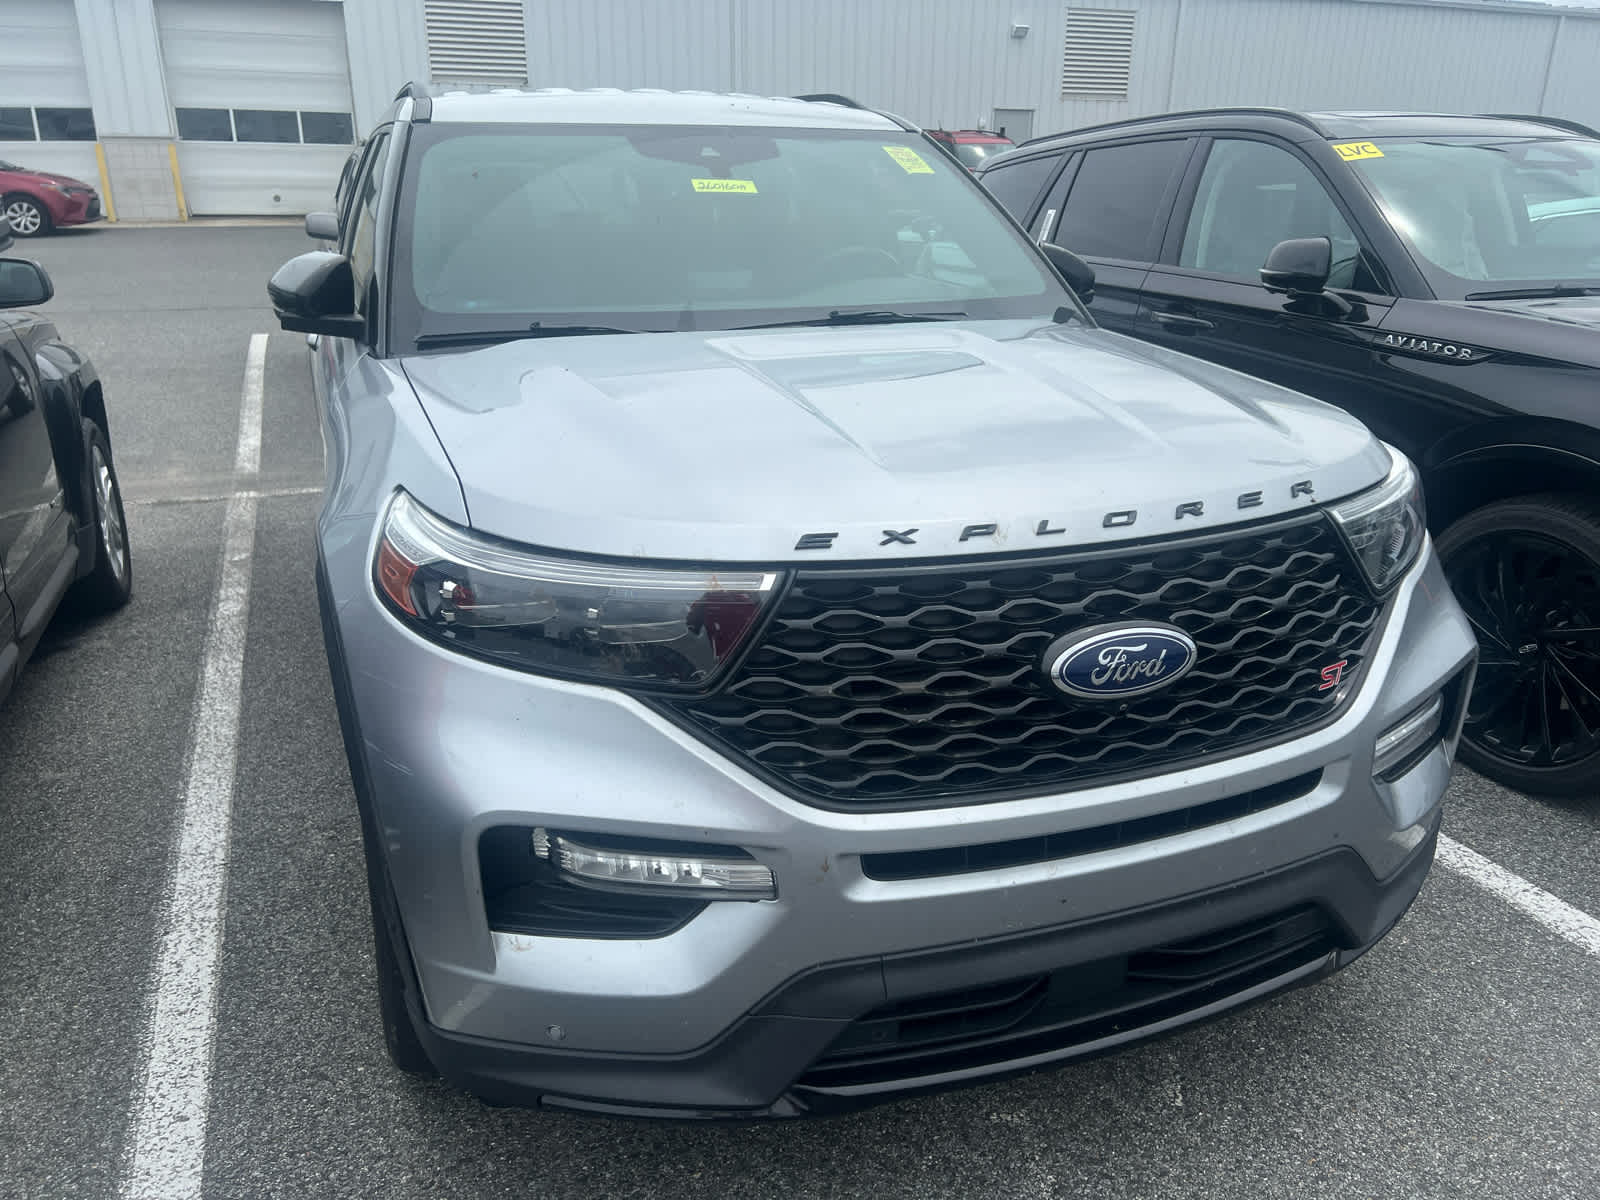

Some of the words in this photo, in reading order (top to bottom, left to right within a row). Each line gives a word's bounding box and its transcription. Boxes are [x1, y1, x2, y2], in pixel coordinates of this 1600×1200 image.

[1336, 144, 1377, 156] LVC
[1384, 334, 1473, 359] AVIATOR
[795, 480, 1314, 551] EXPLORER
[1091, 643, 1167, 685] Ford
[1319, 660, 1347, 690] ST
